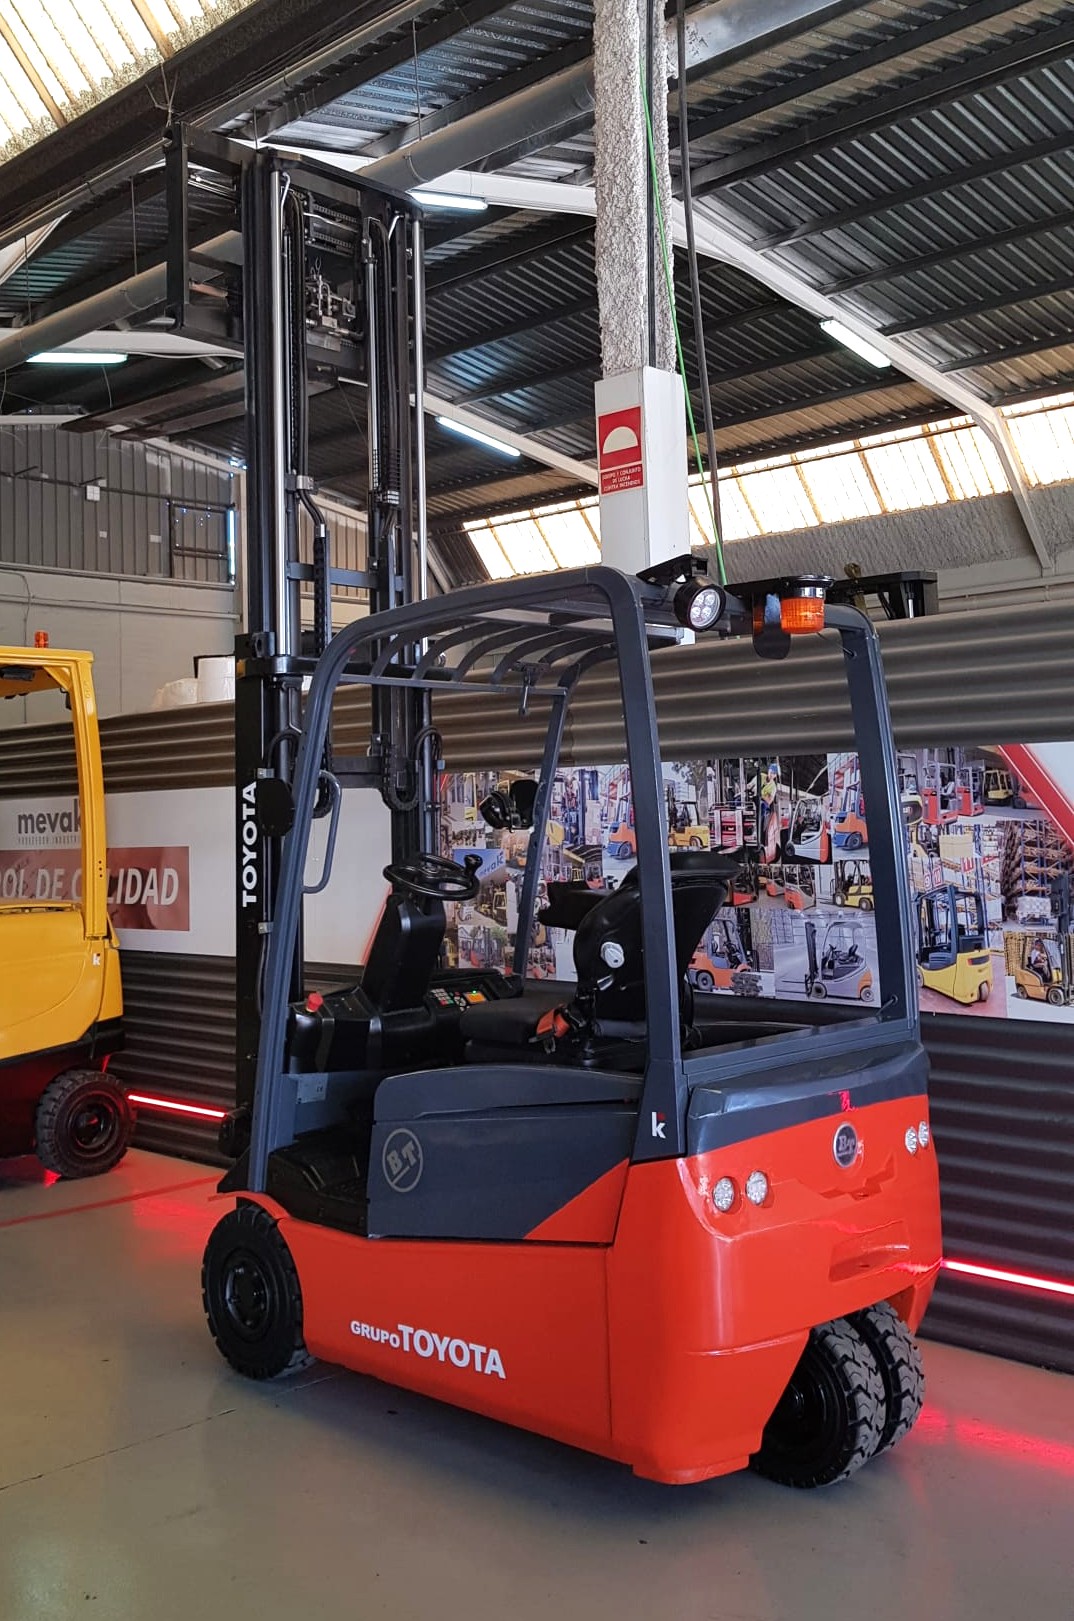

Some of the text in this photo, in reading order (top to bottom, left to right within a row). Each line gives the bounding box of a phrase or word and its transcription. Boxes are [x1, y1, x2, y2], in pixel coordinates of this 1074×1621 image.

[242, 780, 258, 908] TOYOTA
[36, 868, 66, 900] DE
[71, 867, 179, 906] CLIDAD
[651, 1111, 667, 1139] k
[386, 1140, 417, 1176] BT
[350, 1320, 507, 1380] GRUPO TOYOTA
